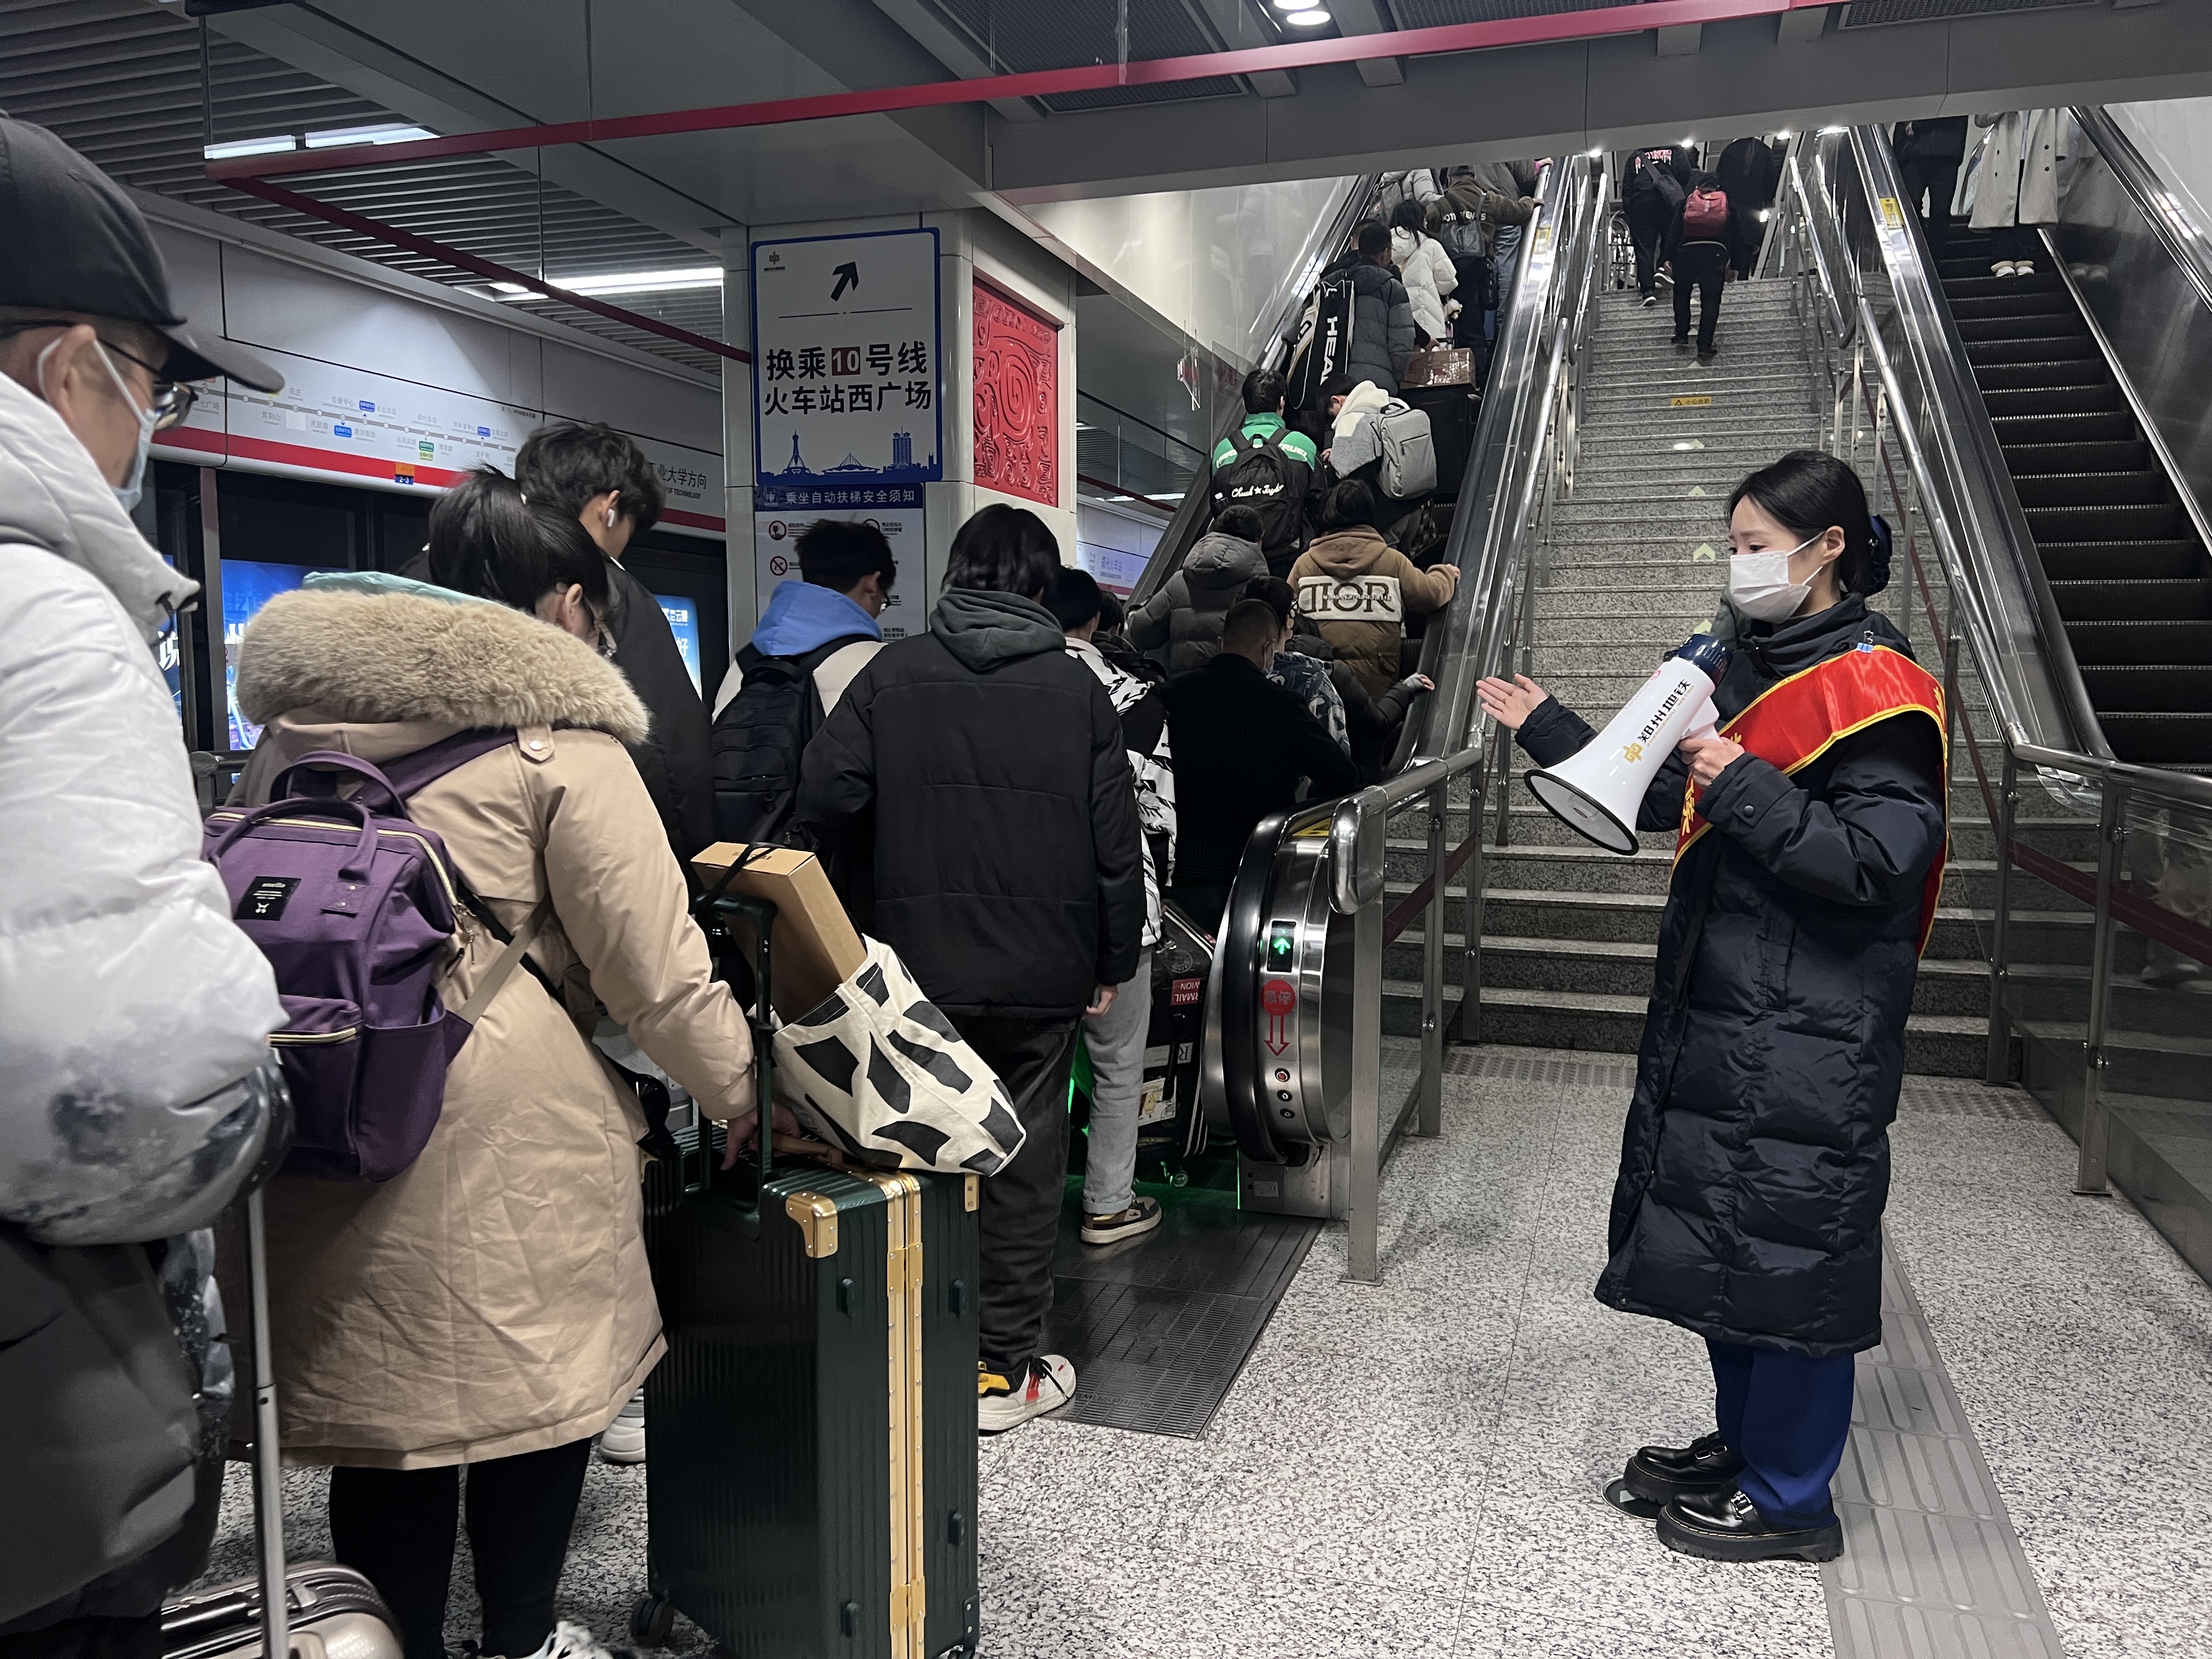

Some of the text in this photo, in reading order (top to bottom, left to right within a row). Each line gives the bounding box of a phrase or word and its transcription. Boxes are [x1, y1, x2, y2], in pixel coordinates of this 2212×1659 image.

[766, 341, 928, 381] 换乘10号线
[765, 381, 932, 416] 火车站西广场
[650, 462, 706, 489] 业大学方向
[786, 489, 915, 505] 乘坐自动扶梯安全须知
[1638, 679, 1691, 743] 郑州地铁
[1646, 685, 1695, 747] ZHENGZHOU METRO
